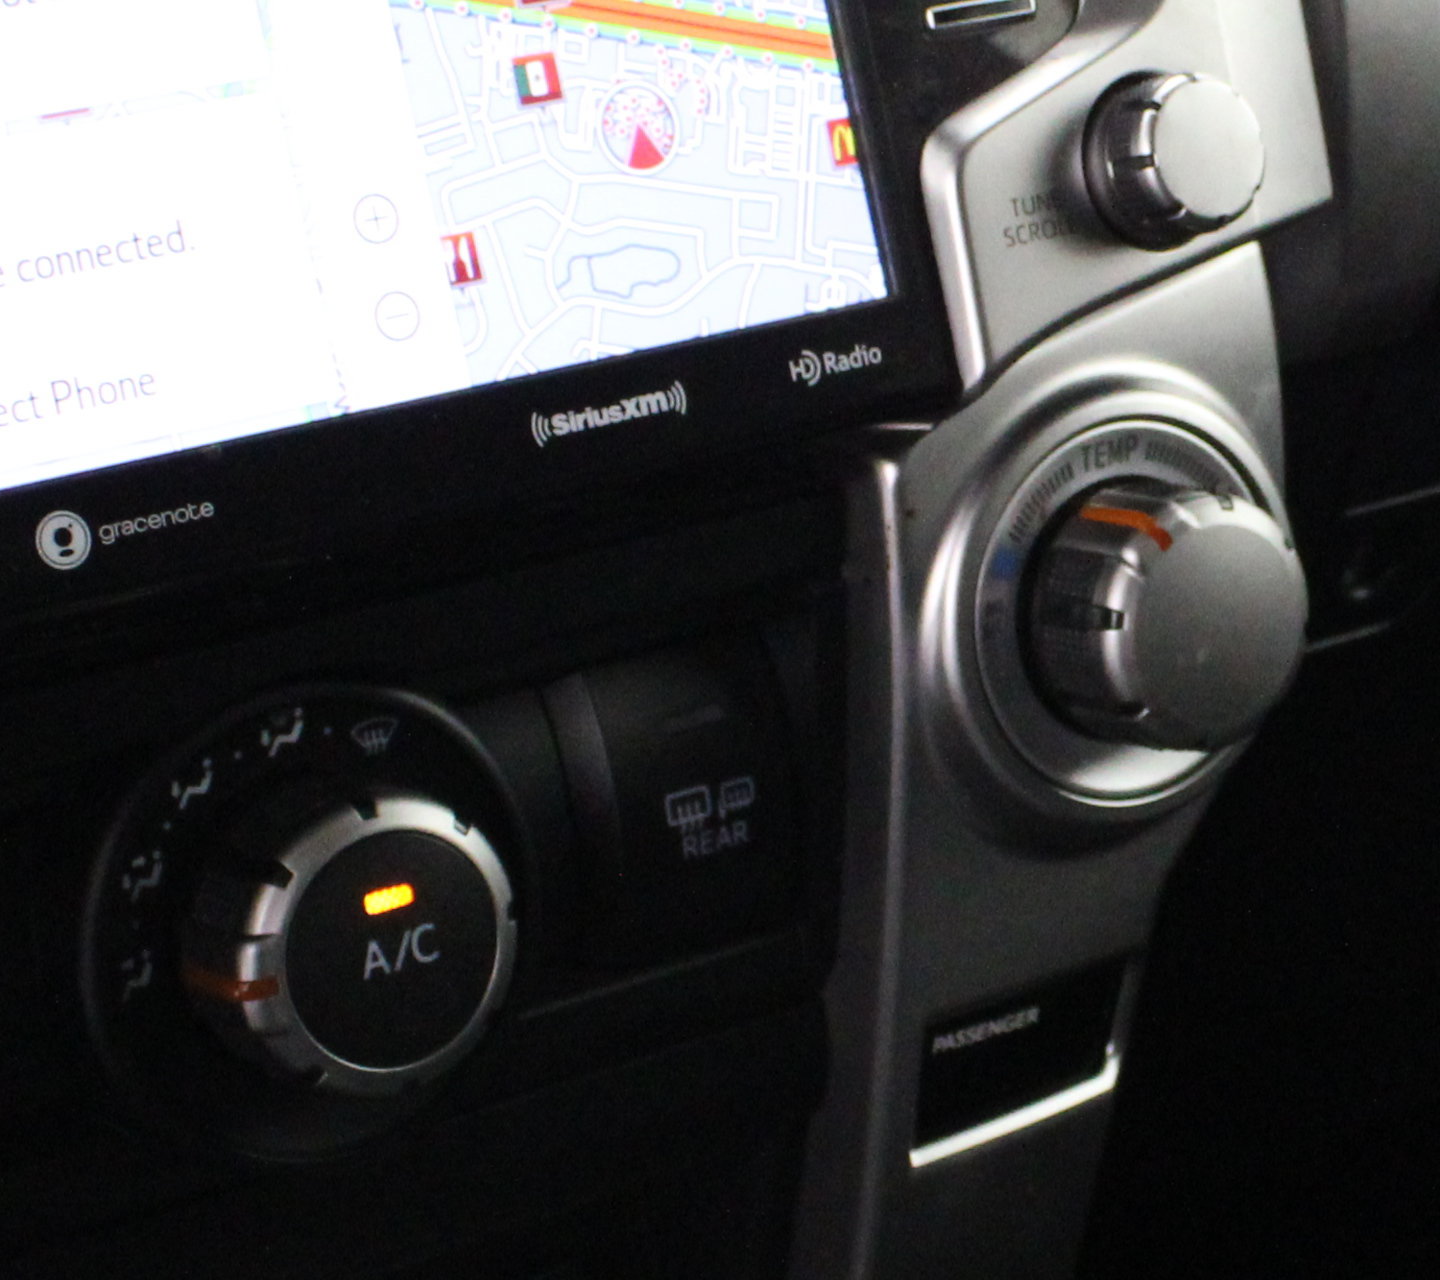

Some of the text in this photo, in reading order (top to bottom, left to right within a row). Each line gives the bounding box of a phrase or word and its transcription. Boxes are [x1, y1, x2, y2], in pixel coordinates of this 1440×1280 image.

[17, 220, 197, 284] connected.
[822, 344, 883, 375] Radio
[51, 369, 157, 416] Phone
[1081, 433, 1139, 474] TEMP
[99, 501, 215, 546] gracenote
[683, 821, 750, 858] REAR
[363, 922, 441, 981] A/C
